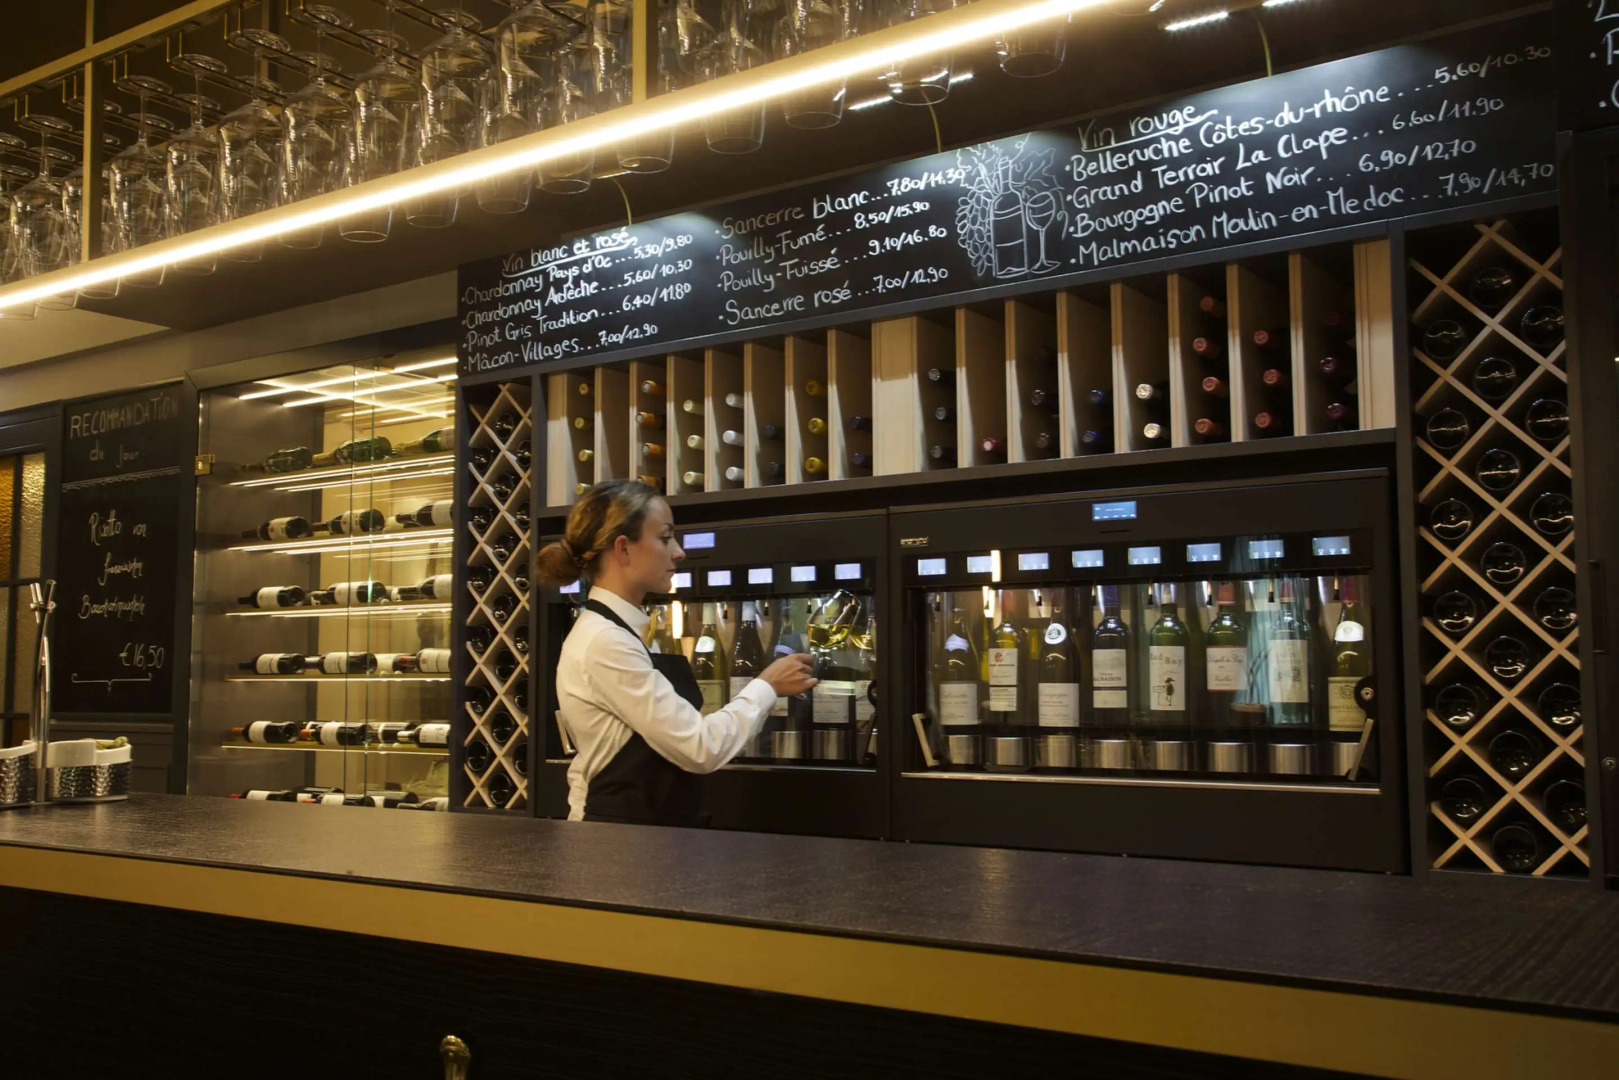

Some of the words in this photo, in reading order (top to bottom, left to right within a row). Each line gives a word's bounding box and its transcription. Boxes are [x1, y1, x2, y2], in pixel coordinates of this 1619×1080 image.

[1071, 138, 1193, 182] Belleruche
[1200, 86, 1391, 147] Côtes-du-rhône
[1078, 119, 1115, 149] Vin
[1129, 105, 1201, 135] rouge
[1073, 171, 1143, 209] Grand
[1152, 156, 1226, 189] Terroir
[1235, 143, 1272, 171] La
[1278, 127, 1348, 159] Clape
[721, 208, 805, 239] Sancerre
[812, 190, 870, 219] blanc
[1073, 196, 1186, 238] Bourgogne
[1186, 177, 1254, 208] Pinot
[1266, 166, 1315, 195] Noir
[720, 224, 827, 266] Pouilly-Fumé
[1079, 222, 1206, 267] Malmaison
[1212, 185, 1405, 239] Moulin-en-Medoc
[503, 253, 524, 272] Vin
[531, 246, 568, 267] blanc
[573, 239, 591, 255] et
[720, 247, 841, 292] Pouilly-Fuissé
[465, 274, 543, 305] Chardonnay
[547, 264, 580, 287] Pays
[582, 255, 612, 273] d'Oc
[725, 294, 805, 325] Sancerre
[814, 280, 852, 307] rosé
[466, 298, 543, 329] Chardonnay
[467, 330, 501, 352] Pinot
[505, 322, 531, 340] Gris
[536, 308, 599, 334] Tradition
[468, 338, 580, 372] Mâcon-Villages
